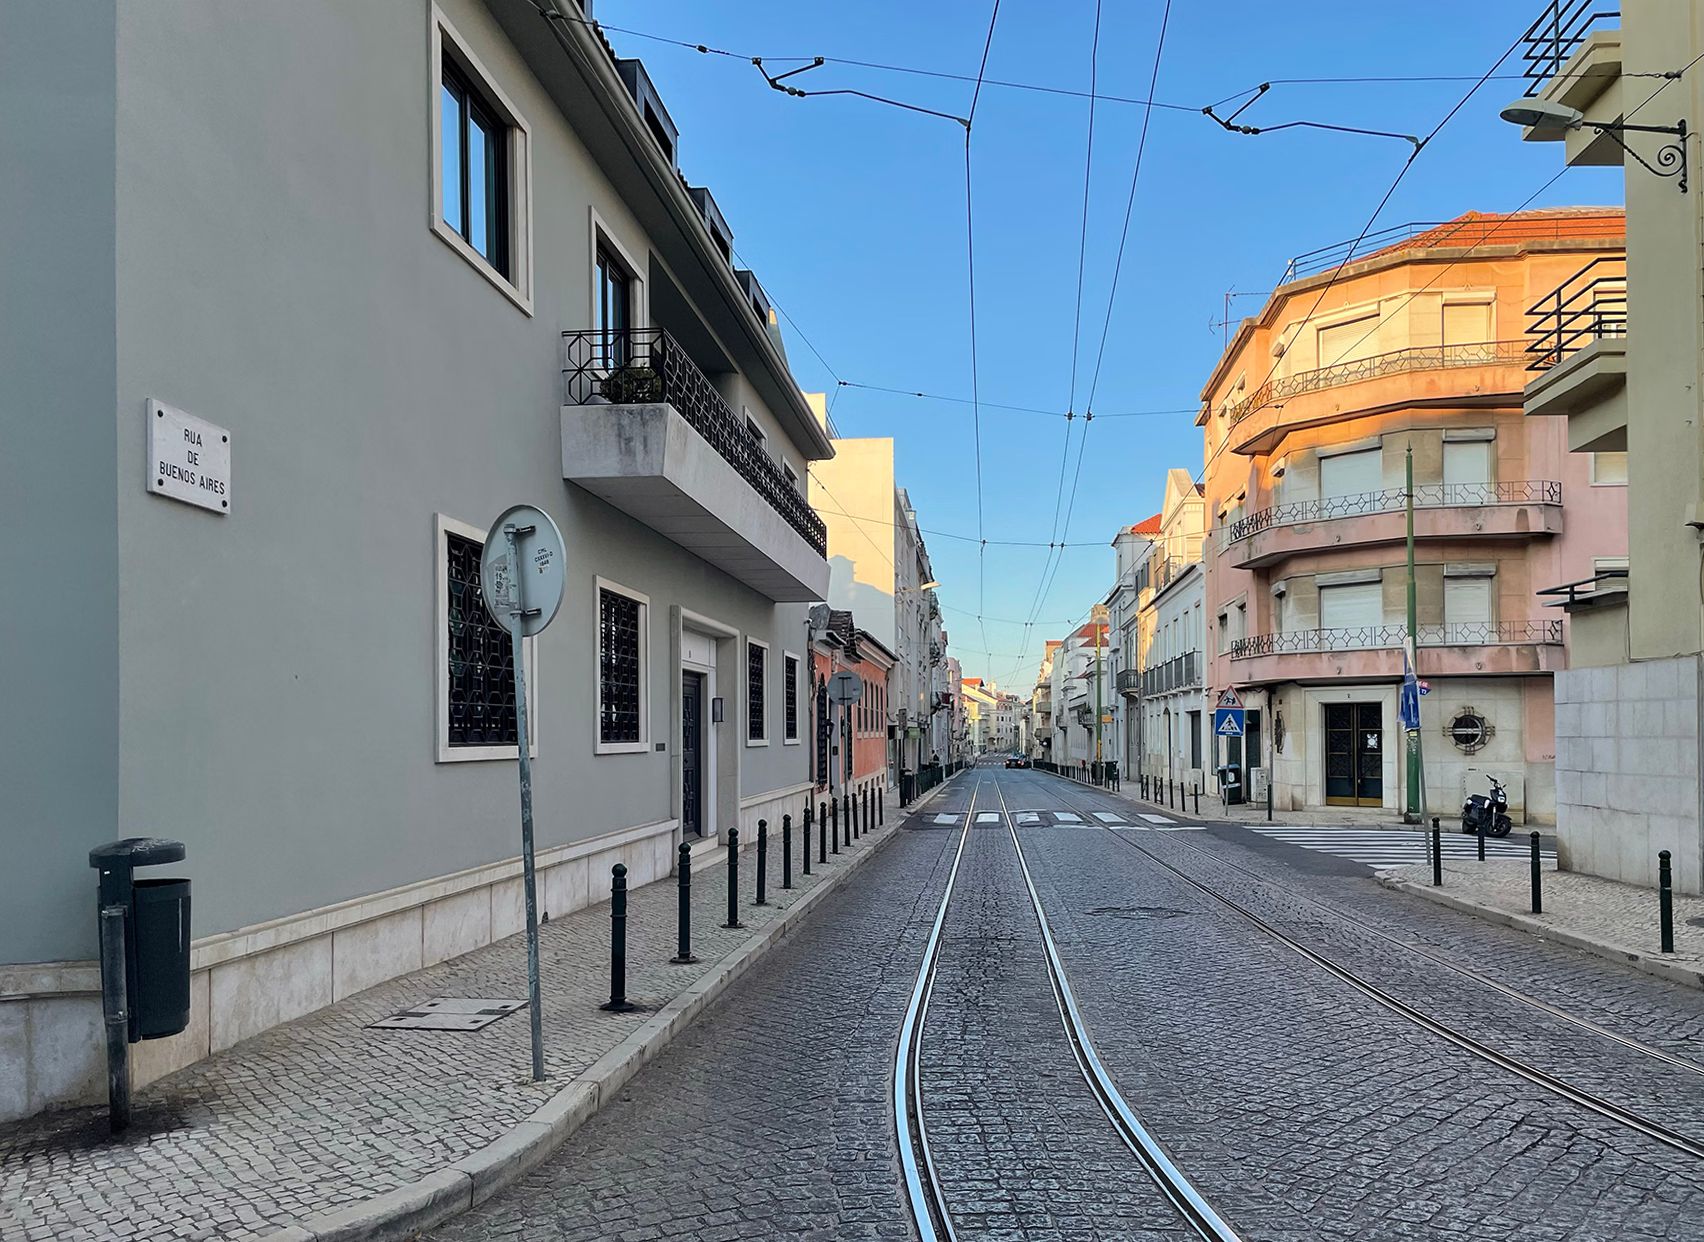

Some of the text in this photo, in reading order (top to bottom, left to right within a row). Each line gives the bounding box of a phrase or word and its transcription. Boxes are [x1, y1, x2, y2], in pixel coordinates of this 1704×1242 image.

[183, 428, 203, 447] RUA
[187, 450, 200, 466] DE
[159, 460, 225, 495] BUENOS AIRES
